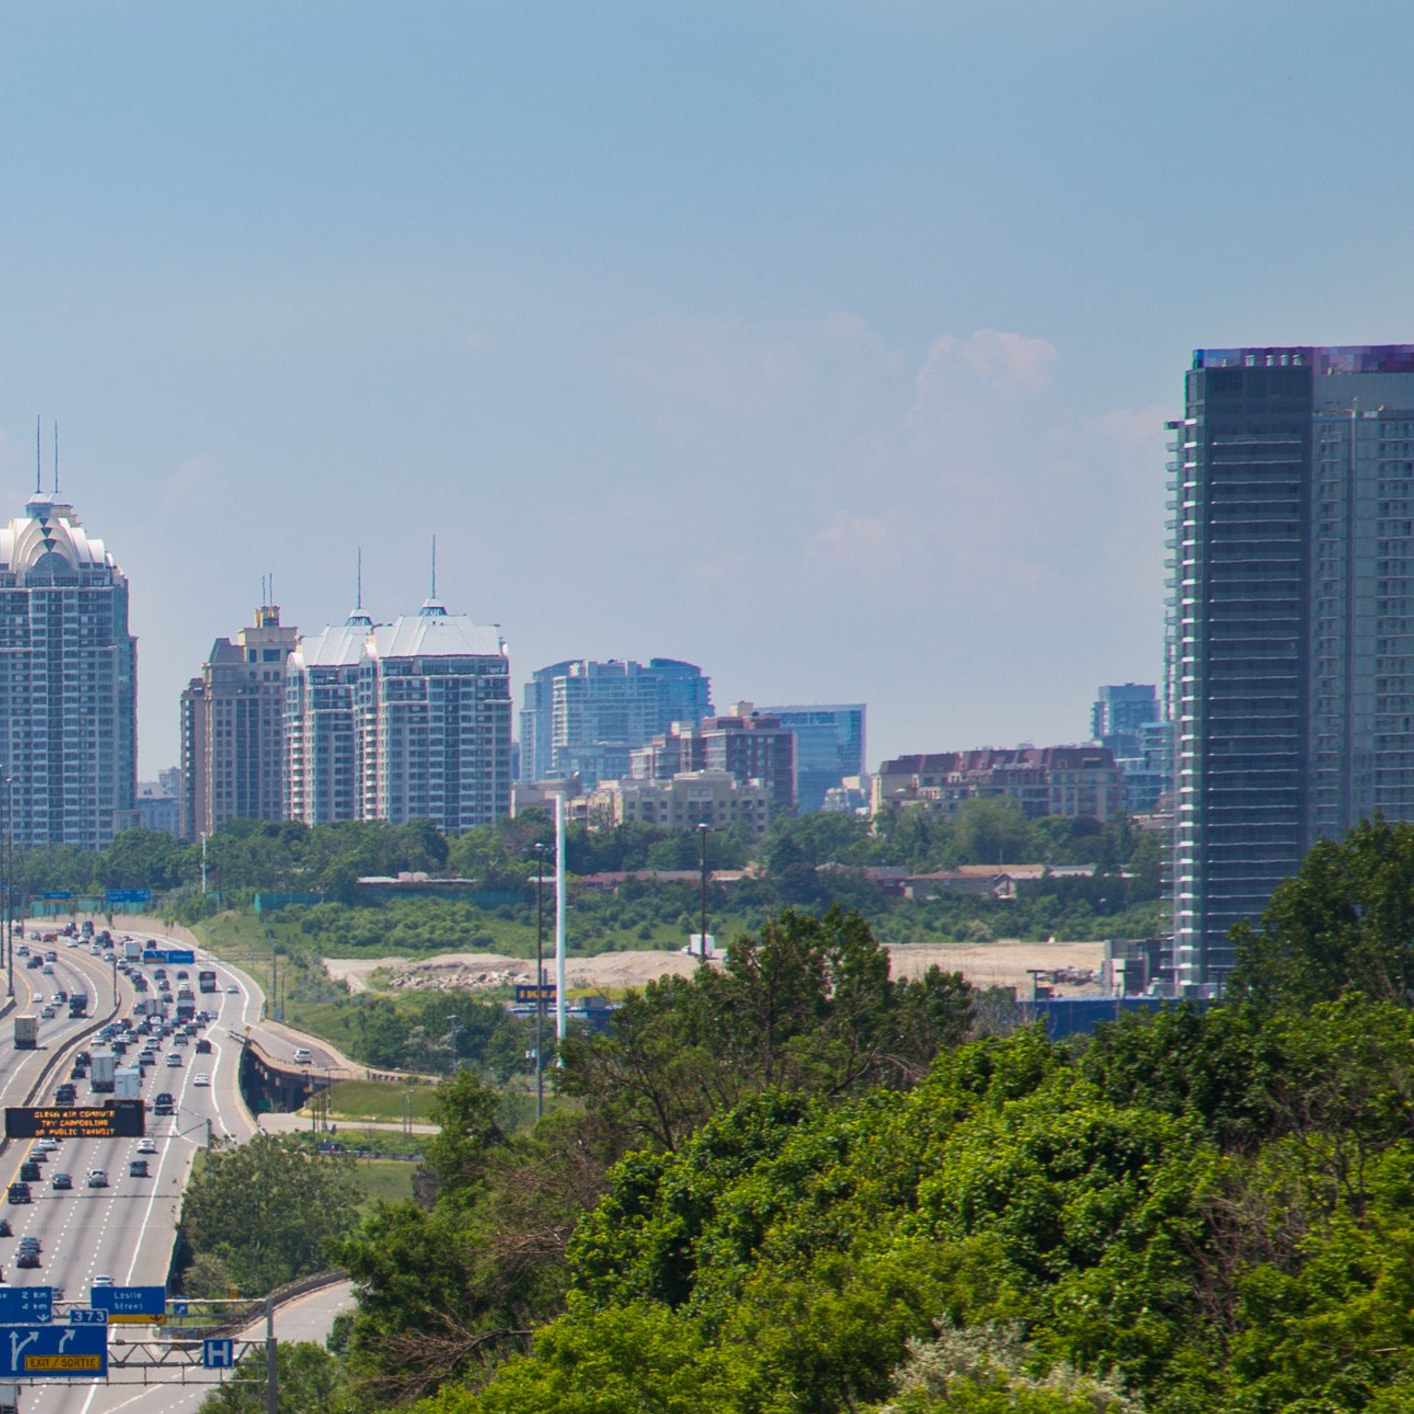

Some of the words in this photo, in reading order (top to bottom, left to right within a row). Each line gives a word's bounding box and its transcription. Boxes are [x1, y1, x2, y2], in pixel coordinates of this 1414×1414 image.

[21, 1291, 28, 1299] 2
[33, 1291, 47, 1299] km
[114, 1291, 142, 1299] Leslie
[114, 1302, 144, 1310] Street
[74, 1311, 105, 1322] 373
[30, 1357, 49, 1367] EXIT
[62, 1357, 95, 1367] SORTIE
